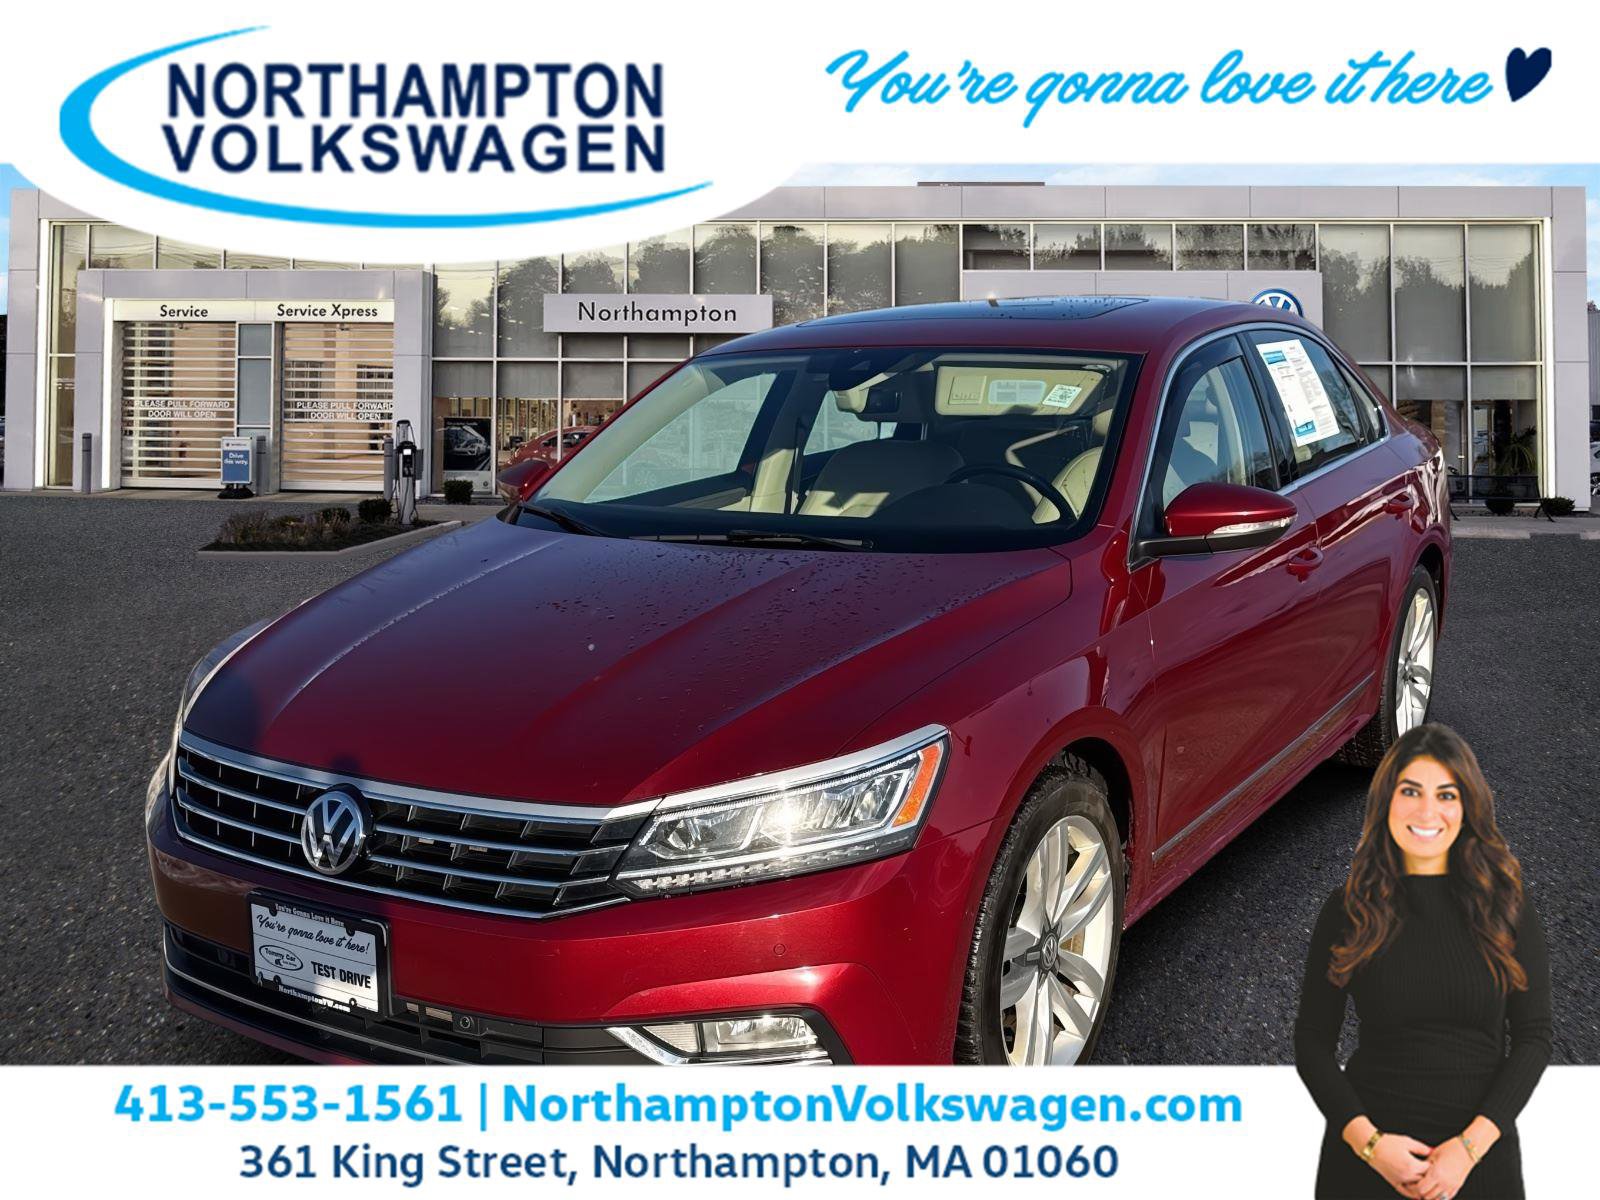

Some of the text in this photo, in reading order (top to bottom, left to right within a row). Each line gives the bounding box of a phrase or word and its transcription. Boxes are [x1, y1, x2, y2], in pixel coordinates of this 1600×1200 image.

[159, 305, 209, 317] Service
[277, 304, 378, 319] Service Xpress
[578, 301, 737, 326] Northampton
[167, 400, 188, 408] PULL
[190, 401, 230, 409] FORWARD
[296, 401, 328, 409] PLEASE
[330, 402, 352, 410] PULL
[193, 411, 217, 419] OPEN
[357, 412, 381, 420] OPEN
[256, 914, 286, 932] You're
[288, 927, 314, 939] gonna
[315, 930, 335, 944] love
[311, 961, 371, 990] TEST DRIVE
